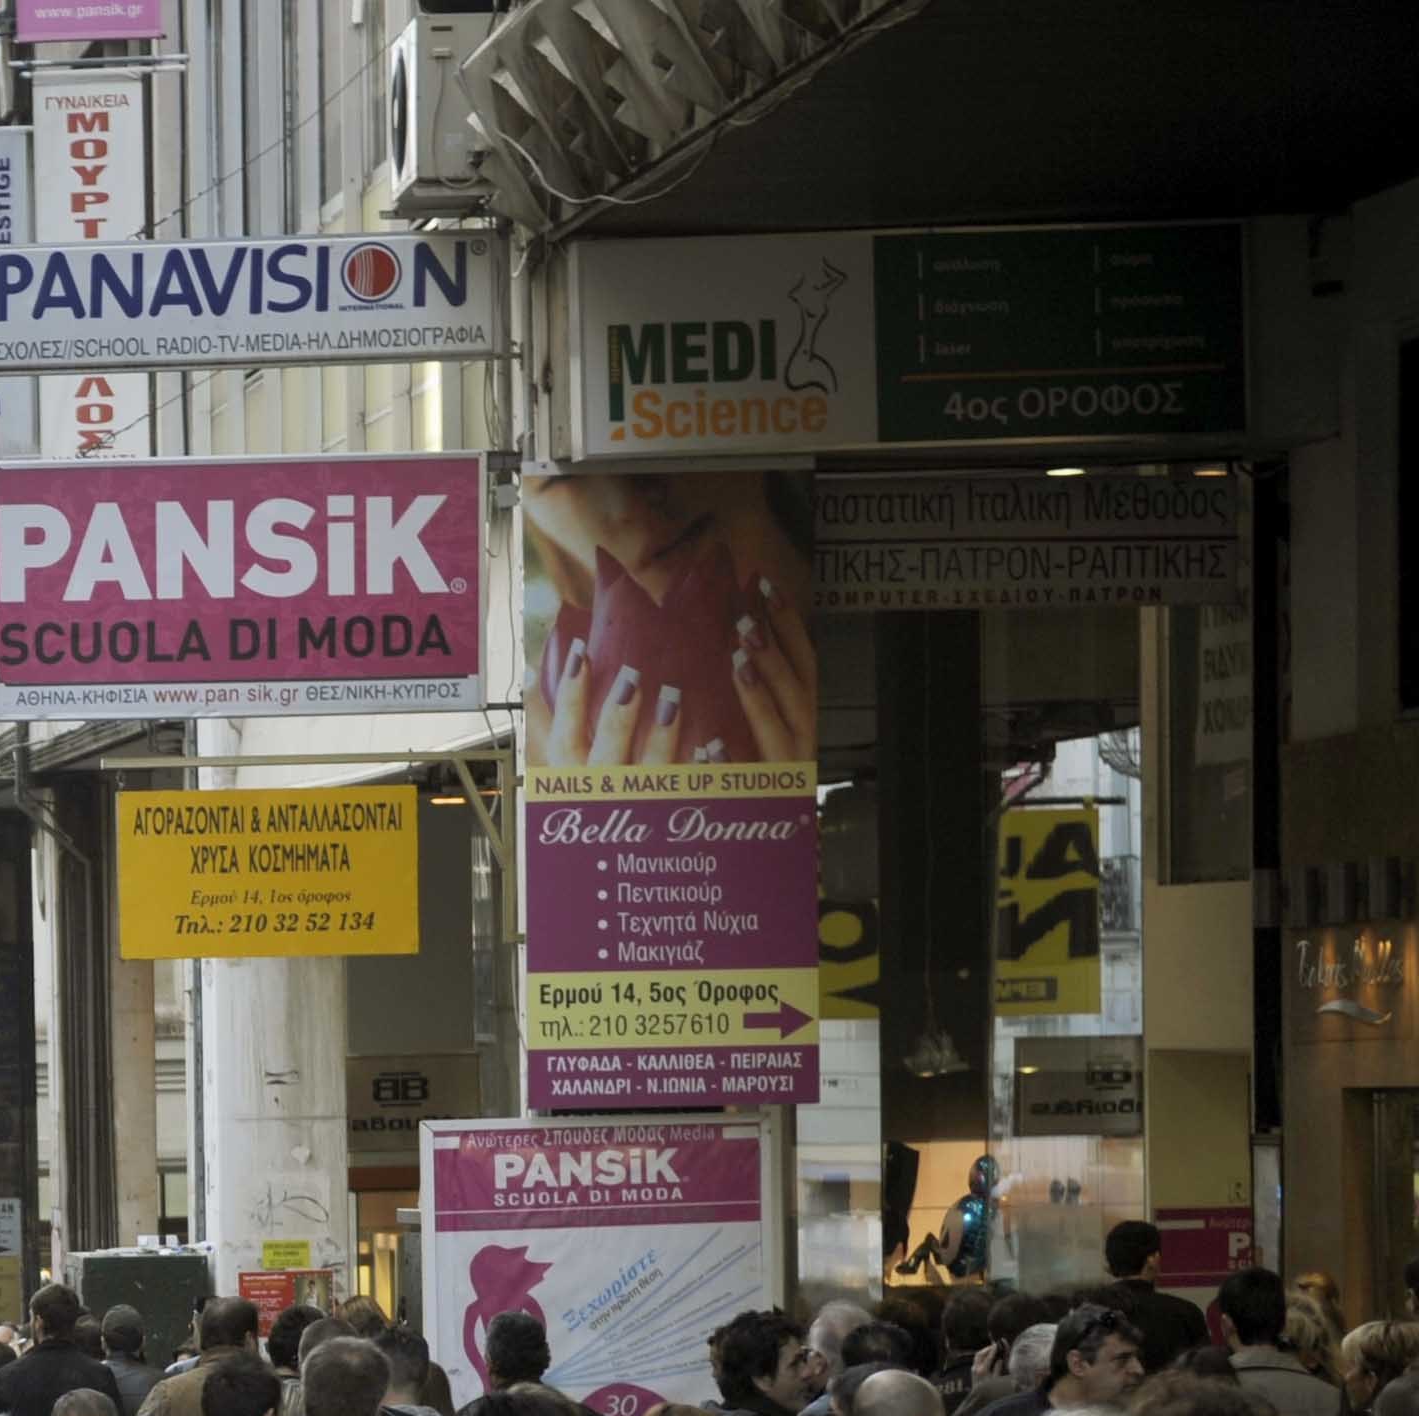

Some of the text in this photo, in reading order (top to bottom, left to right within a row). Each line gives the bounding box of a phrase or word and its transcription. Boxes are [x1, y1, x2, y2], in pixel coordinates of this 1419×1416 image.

[35, 4, 143, 20] www.pansik.gr
[45, 93, 130, 111] ΓΥΝΑΙΚΕΙΑ
[631, 388, 829, 440] Science
[944, 383, 1186, 425] 4ος ΟΡΟΦΟΣ
[967, 482, 1228, 530] Ιταλική Μέθοδος
[814, 545, 1227, 583] ΤΙΚΗΣ-ΠΑΤΡΟΝ-ΡΑΠΤΙΚΗΣ
[0, 613, 452, 667] SCUOLA DI MODA
[15, 685, 148, 706] ΑΘΗΝΑ-ΚΗΦΙΣΙΑ
[535, 770, 808, 795] NAILS & MAKE UP STUDIOS
[134, 802, 403, 835] ΑΓΟΡΑΖΟΝΤΑΙ & ΑΝΤΑΛΛΑΣΟΝΤΑΙ
[538, 804, 799, 845] Bella Donna
[190, 843, 351, 875] ΧΡΥΣΑ ΚΟΣΜΗΜΑΤΑ
[617, 853, 718, 876] Μανικιούρ
[617, 883, 723, 905] Πεντικιούρ
[229, 913, 268, 934] 210
[273, 913, 299, 933] 32
[305, 912, 330, 932] 52
[338, 911, 376, 931] 134
[617, 909, 760, 937] Τεχνητά Νύχια
[617, 940, 705, 967] Μακιγιάζ
[539, 982, 604, 1009] Ερμού
[610, 982, 643, 1008] 14,
[649, 981, 687, 1007] 5ος
[589, 1014, 629, 1037] 210
[634, 1012, 731, 1036] 3257610
[546, 1051, 804, 1073] ΓΛΥΦΑΔΑ ΚΑΛΛΙΘΕΑ ΠΕΙΡΑΙΑΣ
[551, 1074, 794, 1096] ΧΑΛΑΝΔΡΙ Ν.ΙΩΝΙΑ ΜΑΡΟΥΣΙ
[669, 1124, 716, 1142] Media
[493, 1186, 684, 1208] SCUOLA DI MODA
